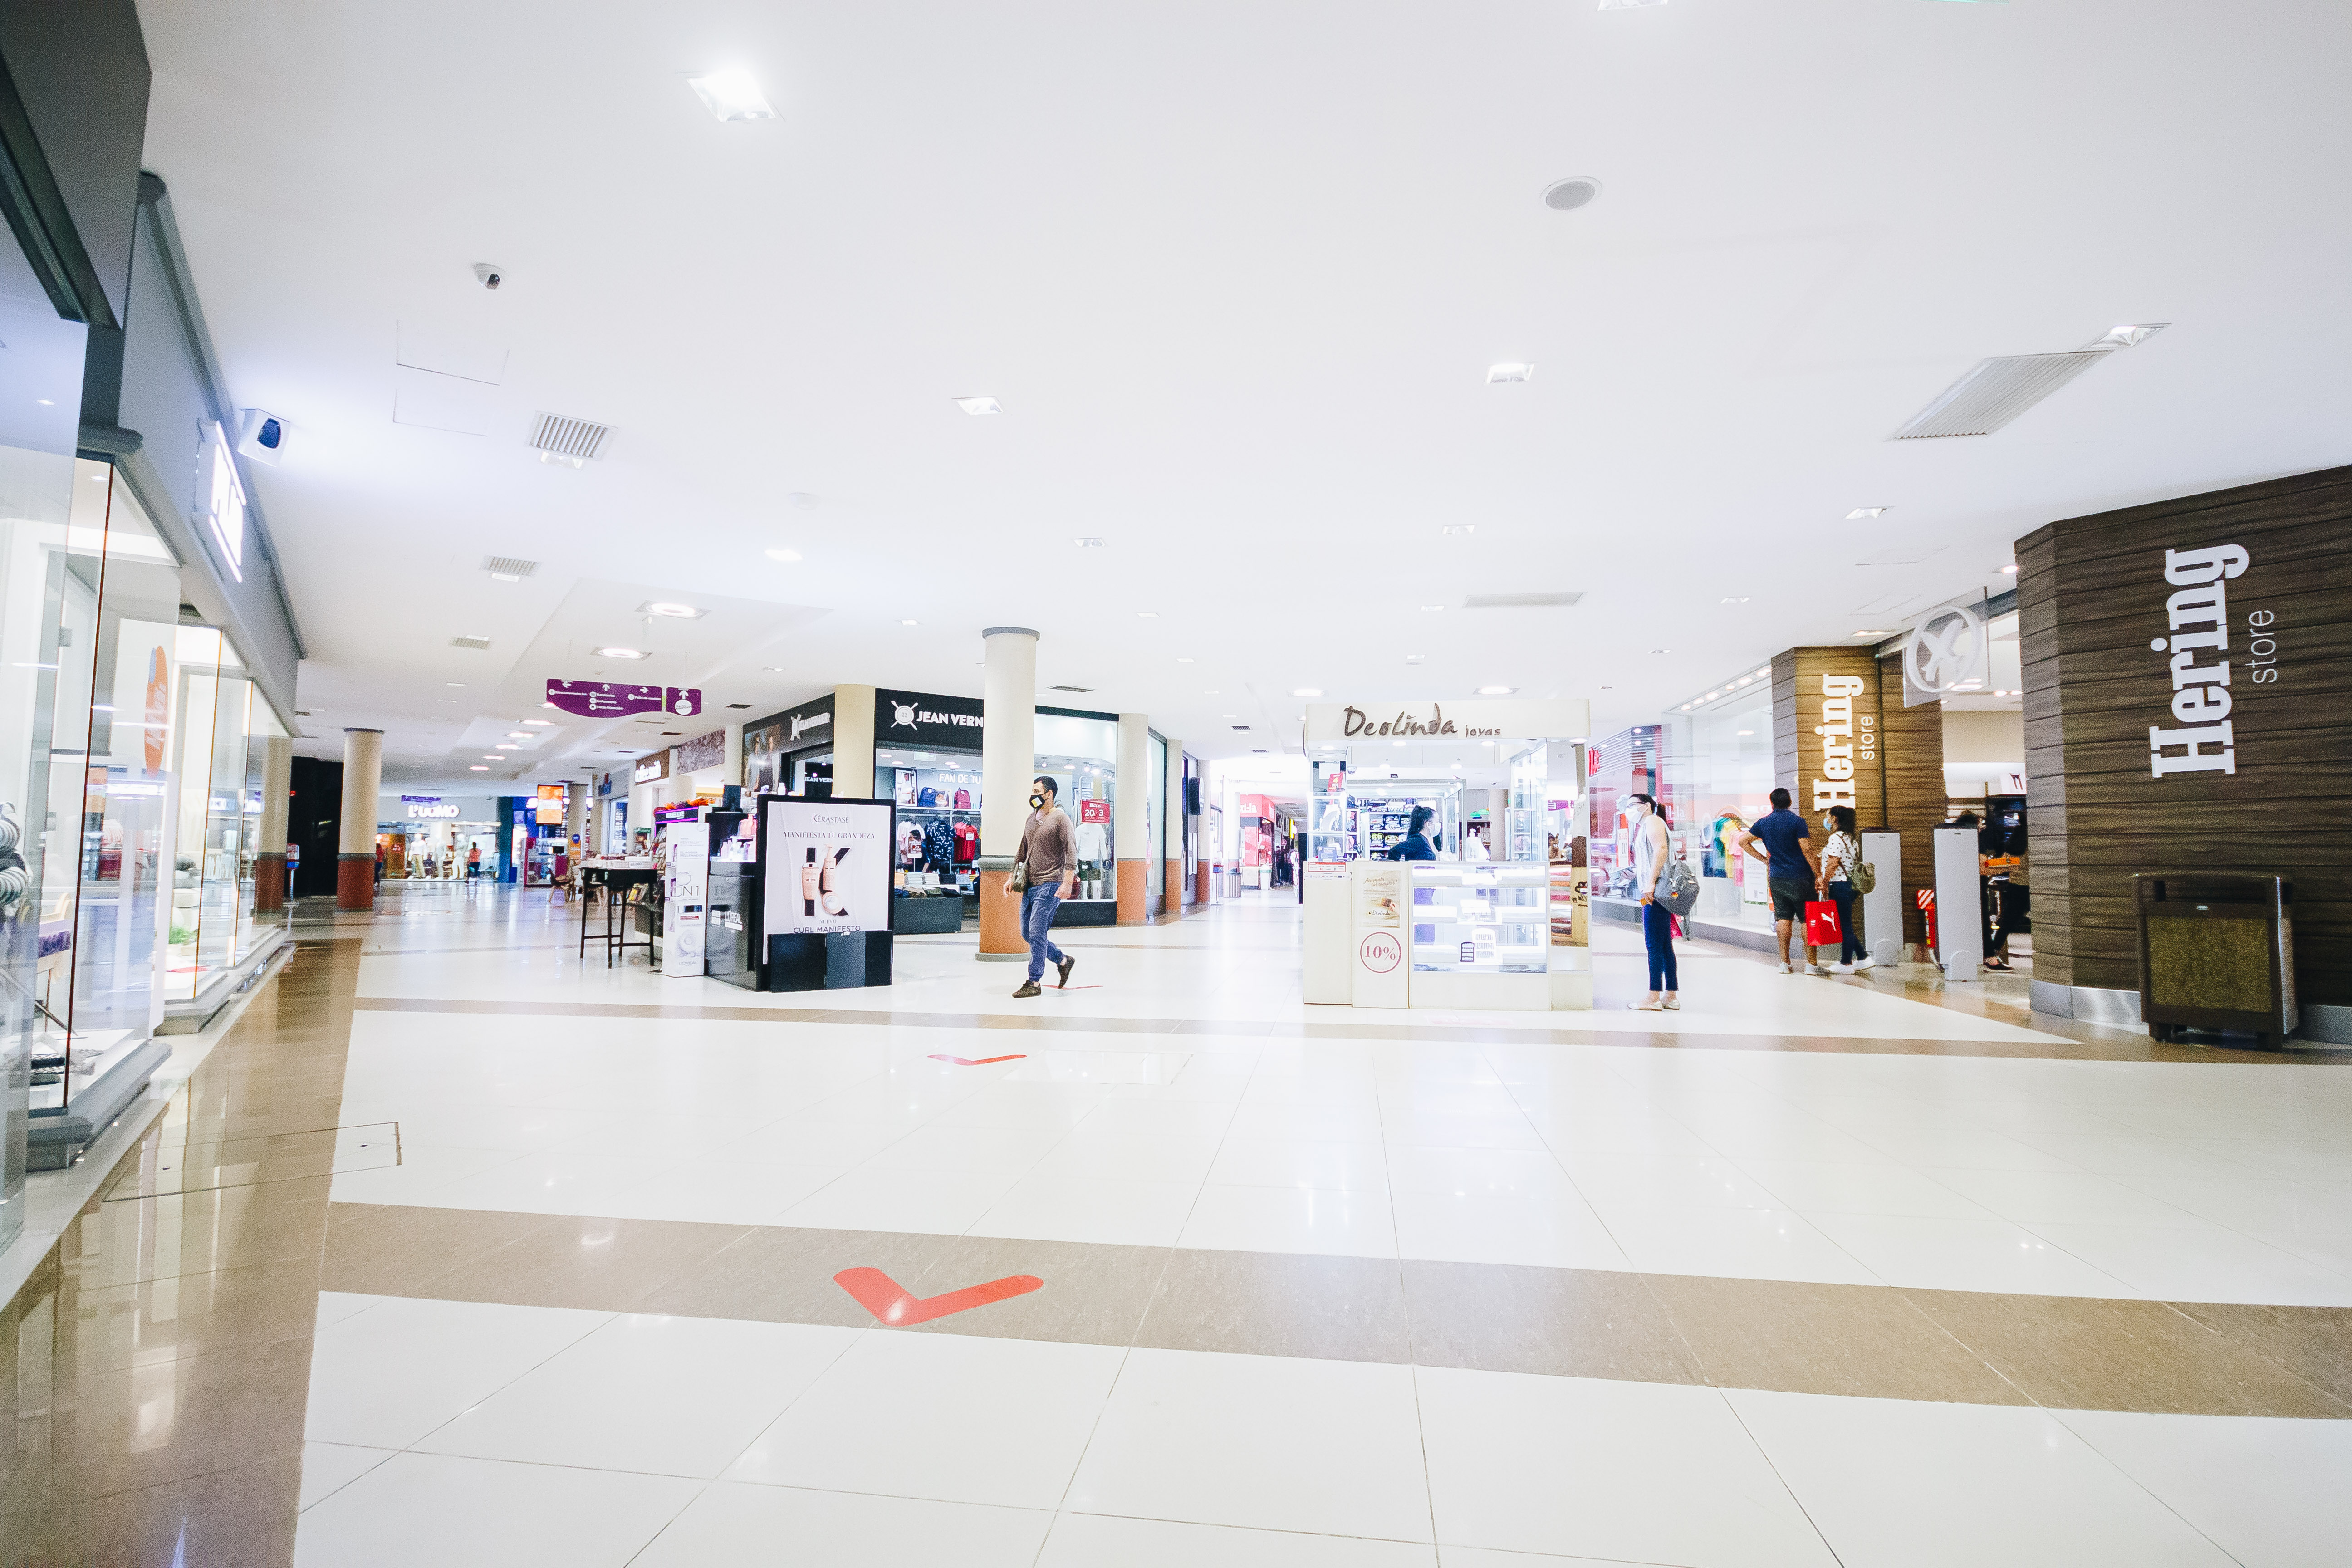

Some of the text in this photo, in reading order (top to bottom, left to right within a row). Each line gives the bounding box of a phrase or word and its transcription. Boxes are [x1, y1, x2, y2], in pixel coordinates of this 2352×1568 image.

[2246, 610, 2278, 683] store
[2149, 544, 2249, 778] Hering
[916, 711, 948, 724] JEAN
[1343, 703, 1501, 738] Deolinda joyas
[1814, 674, 1864, 811] Hering
[1859, 716, 1875, 760] store
[939, 774, 981, 784] FAN DE TU
[408, 805, 460, 818] L'UOMO
[812, 814, 849, 823] KÉRASTASE
[1365, 945, 1396, 960] 10%
